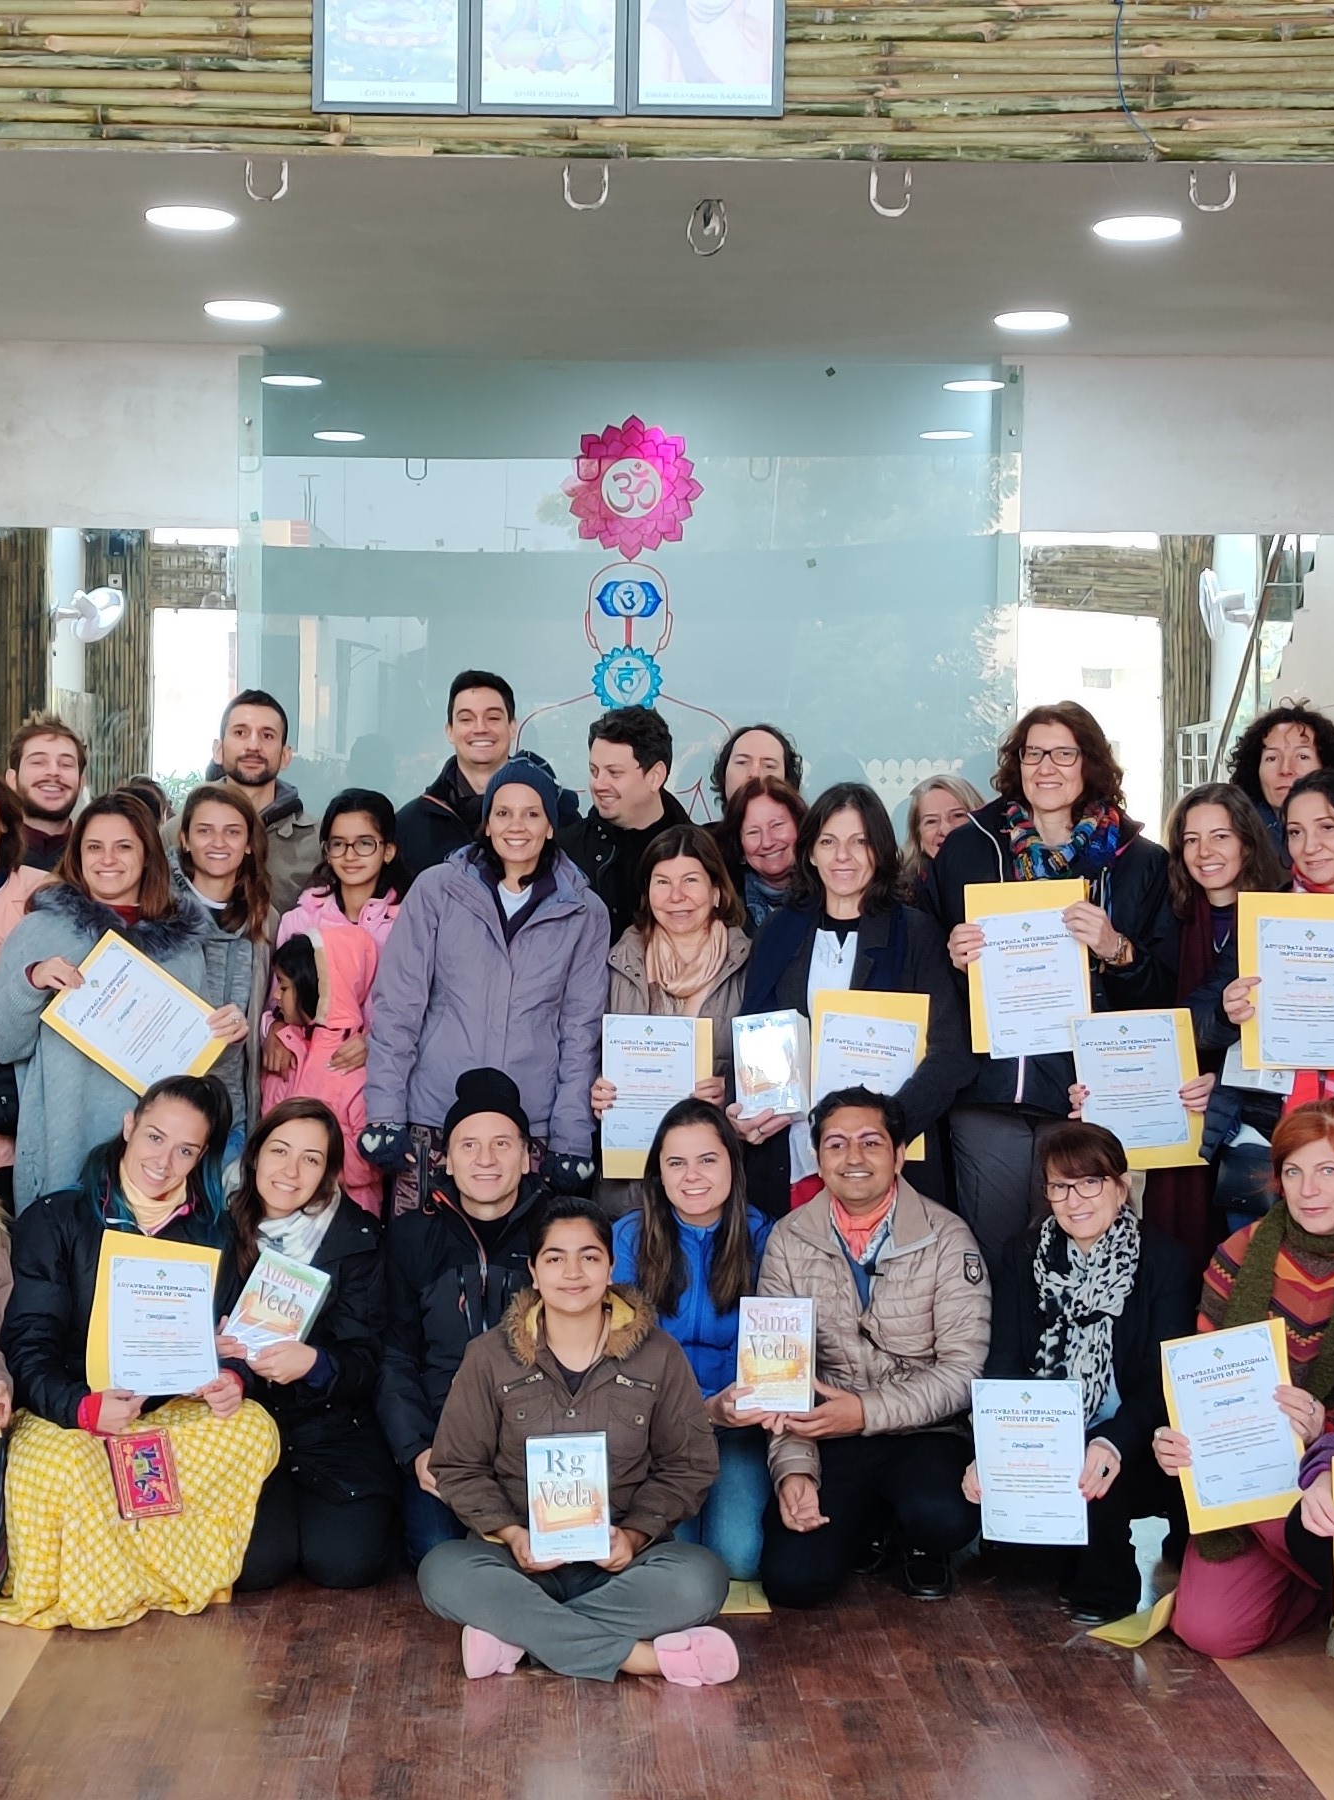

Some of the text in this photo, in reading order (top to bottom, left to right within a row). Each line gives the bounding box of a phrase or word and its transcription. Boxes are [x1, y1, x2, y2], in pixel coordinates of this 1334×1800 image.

[257, 1262, 314, 1298] Atharva
[259, 1280, 304, 1320] Veda
[747, 1334, 798, 1360] Veda
[538, 1480, 595, 1508] Veda
